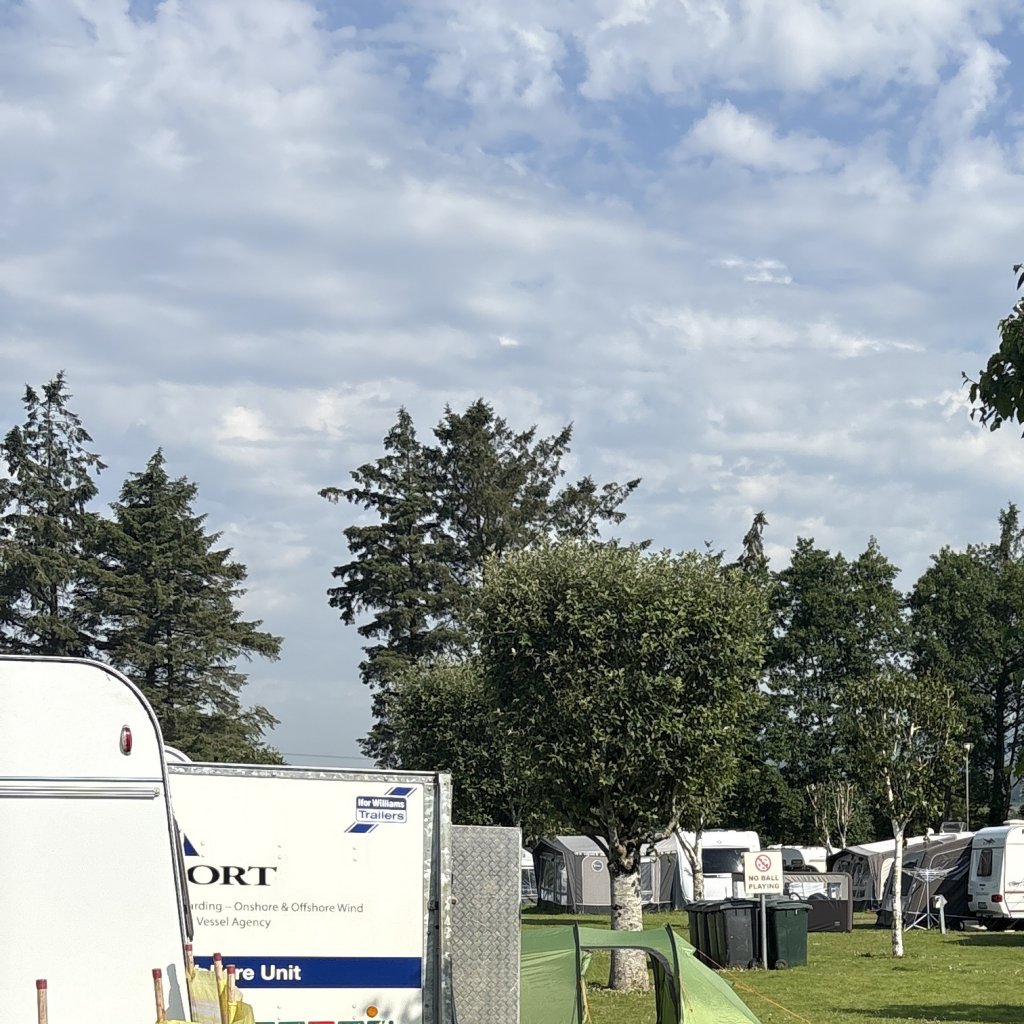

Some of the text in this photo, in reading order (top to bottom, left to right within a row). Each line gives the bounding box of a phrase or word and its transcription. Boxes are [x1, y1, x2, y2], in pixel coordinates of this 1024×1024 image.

[372, 798, 405, 808] Williams
[358, 810, 405, 820] Trailers
[187, 864, 278, 886] ORT
[234, 902, 277, 912] Onshore
[280, 903, 289, 912] &
[291, 902, 335, 913] Offshore
[337, 903, 364, 913] Wind
[196, 917, 271, 929] Vessel Agency
[260, 964, 302, 981] Unit
